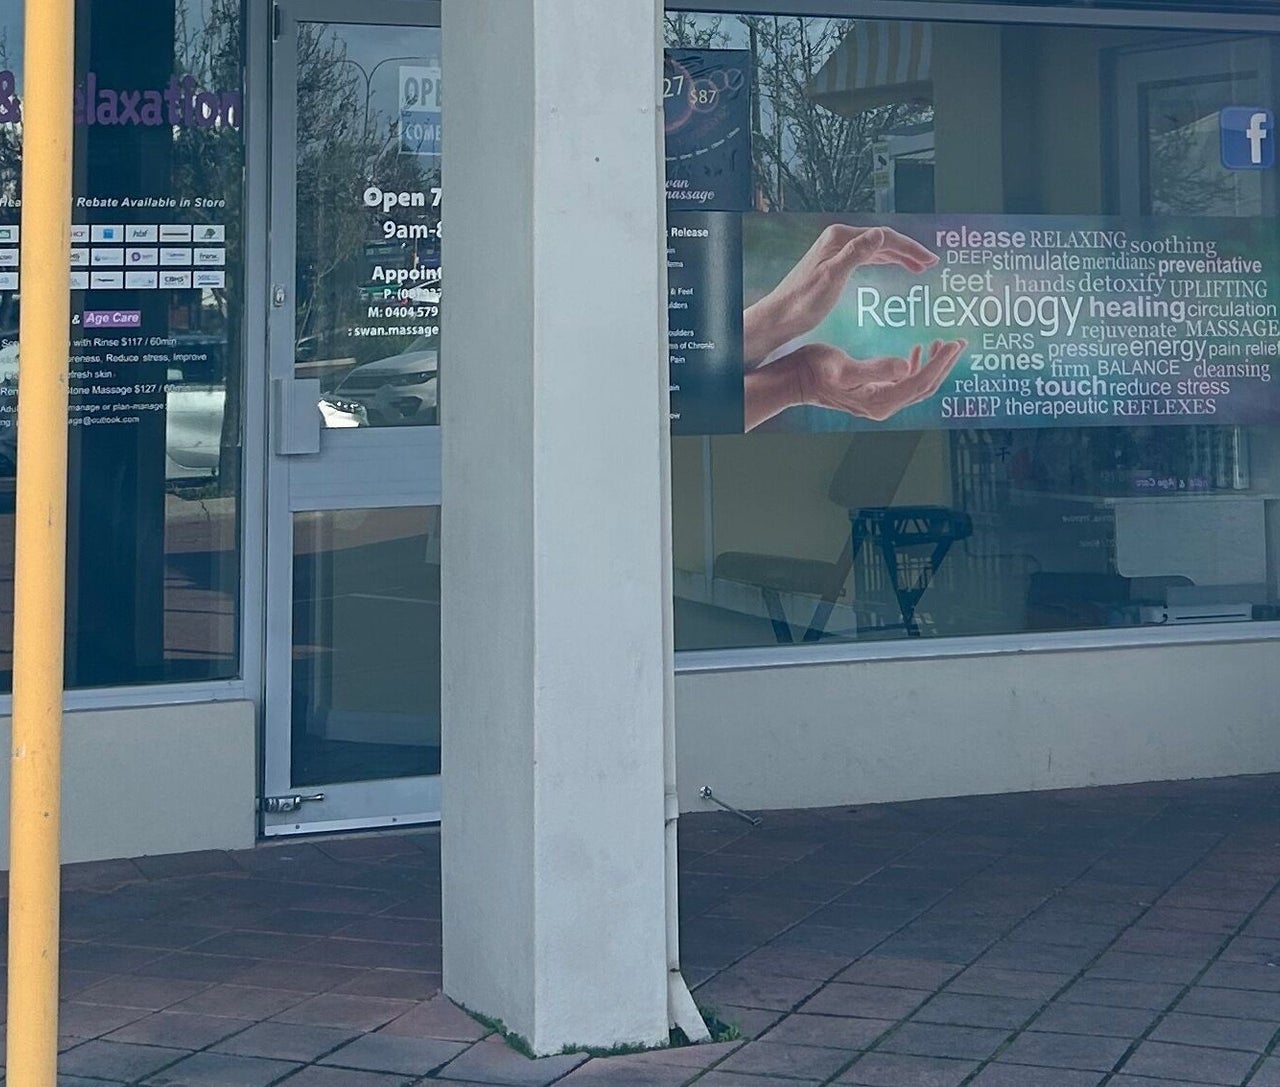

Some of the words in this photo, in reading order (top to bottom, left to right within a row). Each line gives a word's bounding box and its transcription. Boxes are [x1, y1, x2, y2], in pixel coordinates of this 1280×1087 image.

[74, 72, 243, 127] elaxation
[690, 88, 717, 105] $87
[77, 197, 119, 208] Rebate
[121, 197, 177, 208] Available
[180, 197, 191, 207] in
[194, 197, 226, 208] Store
[363, 187, 425, 212] Open
[671, 228, 709, 238] Release
[936, 228, 1026, 249] release
[1030, 230, 1127, 250] RELAXING
[1130, 236, 1218, 259] soothing
[946, 250, 992, 266] DEEP
[992, 250, 1080, 271] stimulate
[1082, 253, 1156, 271] meridians
[1158, 256, 1262, 276] preventative
[941, 269, 994, 292] feet
[1014, 273, 1076, 293] hands
[1078, 273, 1166, 296] detoxify
[1169, 279, 1268, 299] UPLIFTING
[72, 315, 80, 325] &
[86, 313, 110, 325] Age
[112, 312, 139, 323] Care
[368, 307, 383, 318] M:
[385, 307, 414, 318] 0404
[416, 306, 439, 318] 579
[857, 285, 1083, 336] Reflexology
[1089, 296, 1187, 322] healing
[1187, 302, 1277, 317] circulation
[1081, 320, 1177, 340] rejuvenate
[1186, 320, 1280, 338] MASSAGE
[94, 337, 119, 347] Rinse
[982, 333, 1035, 350] EARS
[1048, 340, 1130, 362] pressure
[1130, 339, 1207, 362] energy
[1209, 342, 1242, 360] pain
[970, 352, 1045, 372] zones
[1051, 359, 1091, 379] firm
[1097, 359, 1180, 375] BALANCE
[1193, 359, 1271, 382] cleansing
[91, 385, 133, 396] Massage
[955, 374, 1031, 396] relaxing
[1035, 376, 1107, 396] touch
[1109, 379, 1172, 396] reduce
[1177, 378, 1231, 396] stress
[941, 397, 1001, 419] SLEEP
[1005, 396, 1109, 418] therapeutic
[1113, 398, 1217, 416] REFLEXES
